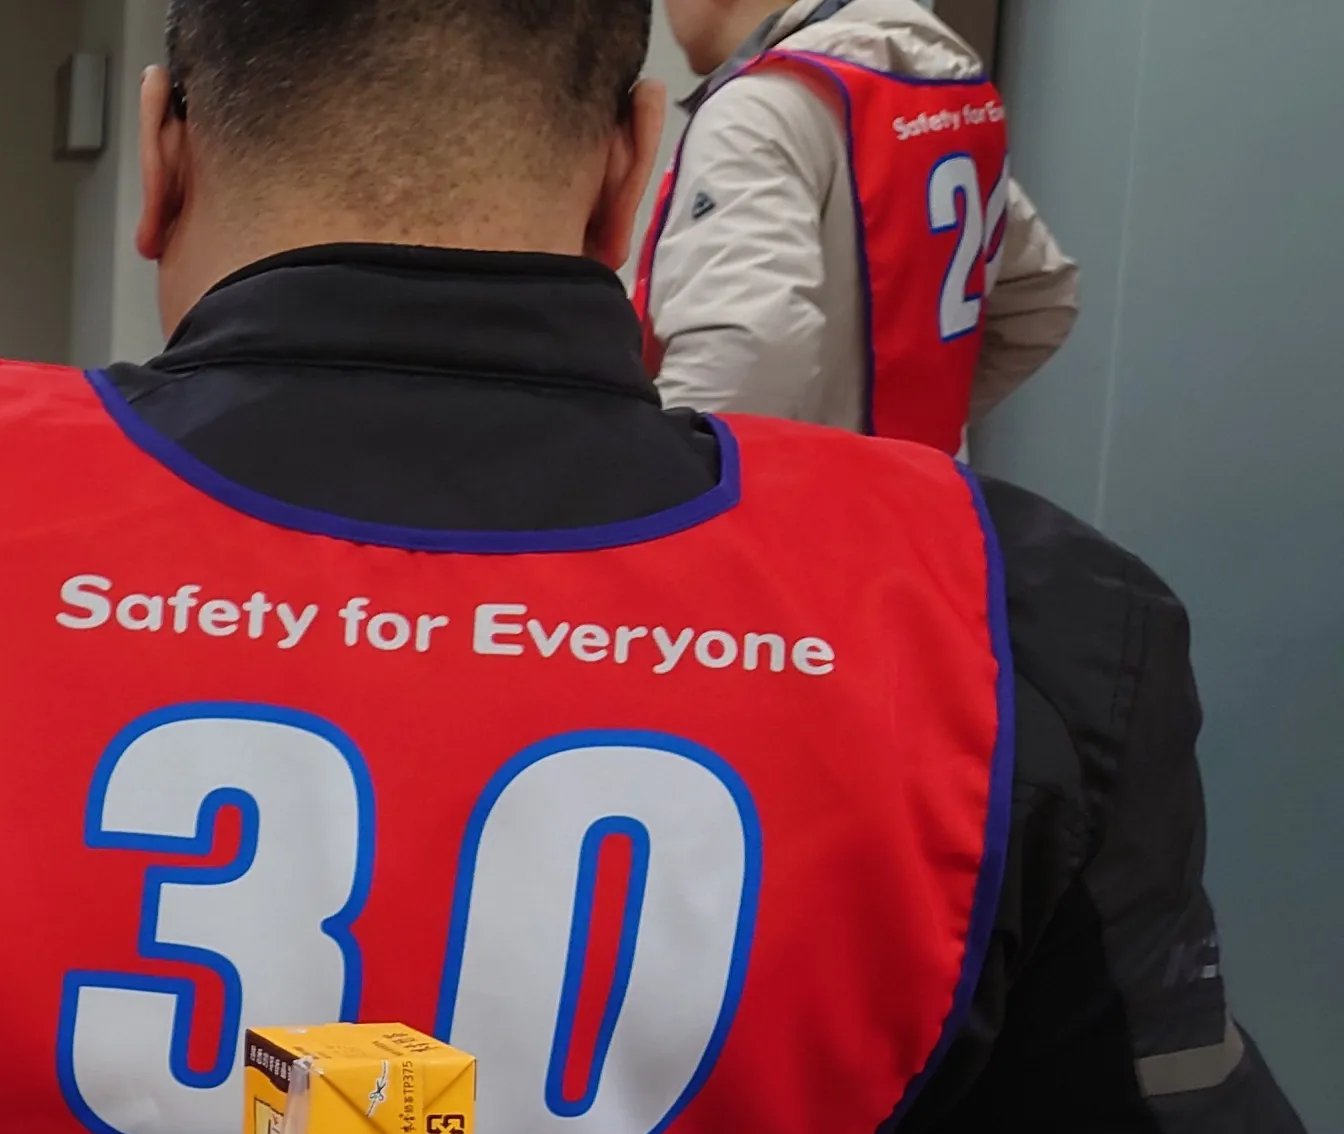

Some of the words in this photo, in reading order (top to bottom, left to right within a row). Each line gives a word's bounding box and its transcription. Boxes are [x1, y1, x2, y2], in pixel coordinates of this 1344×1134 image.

[892, 109, 960, 140] Safety
[962, 103, 986, 125] for
[55, 573, 319, 650] Safety
[338, 596, 450, 652] for
[472, 602, 837, 677] Everyone
